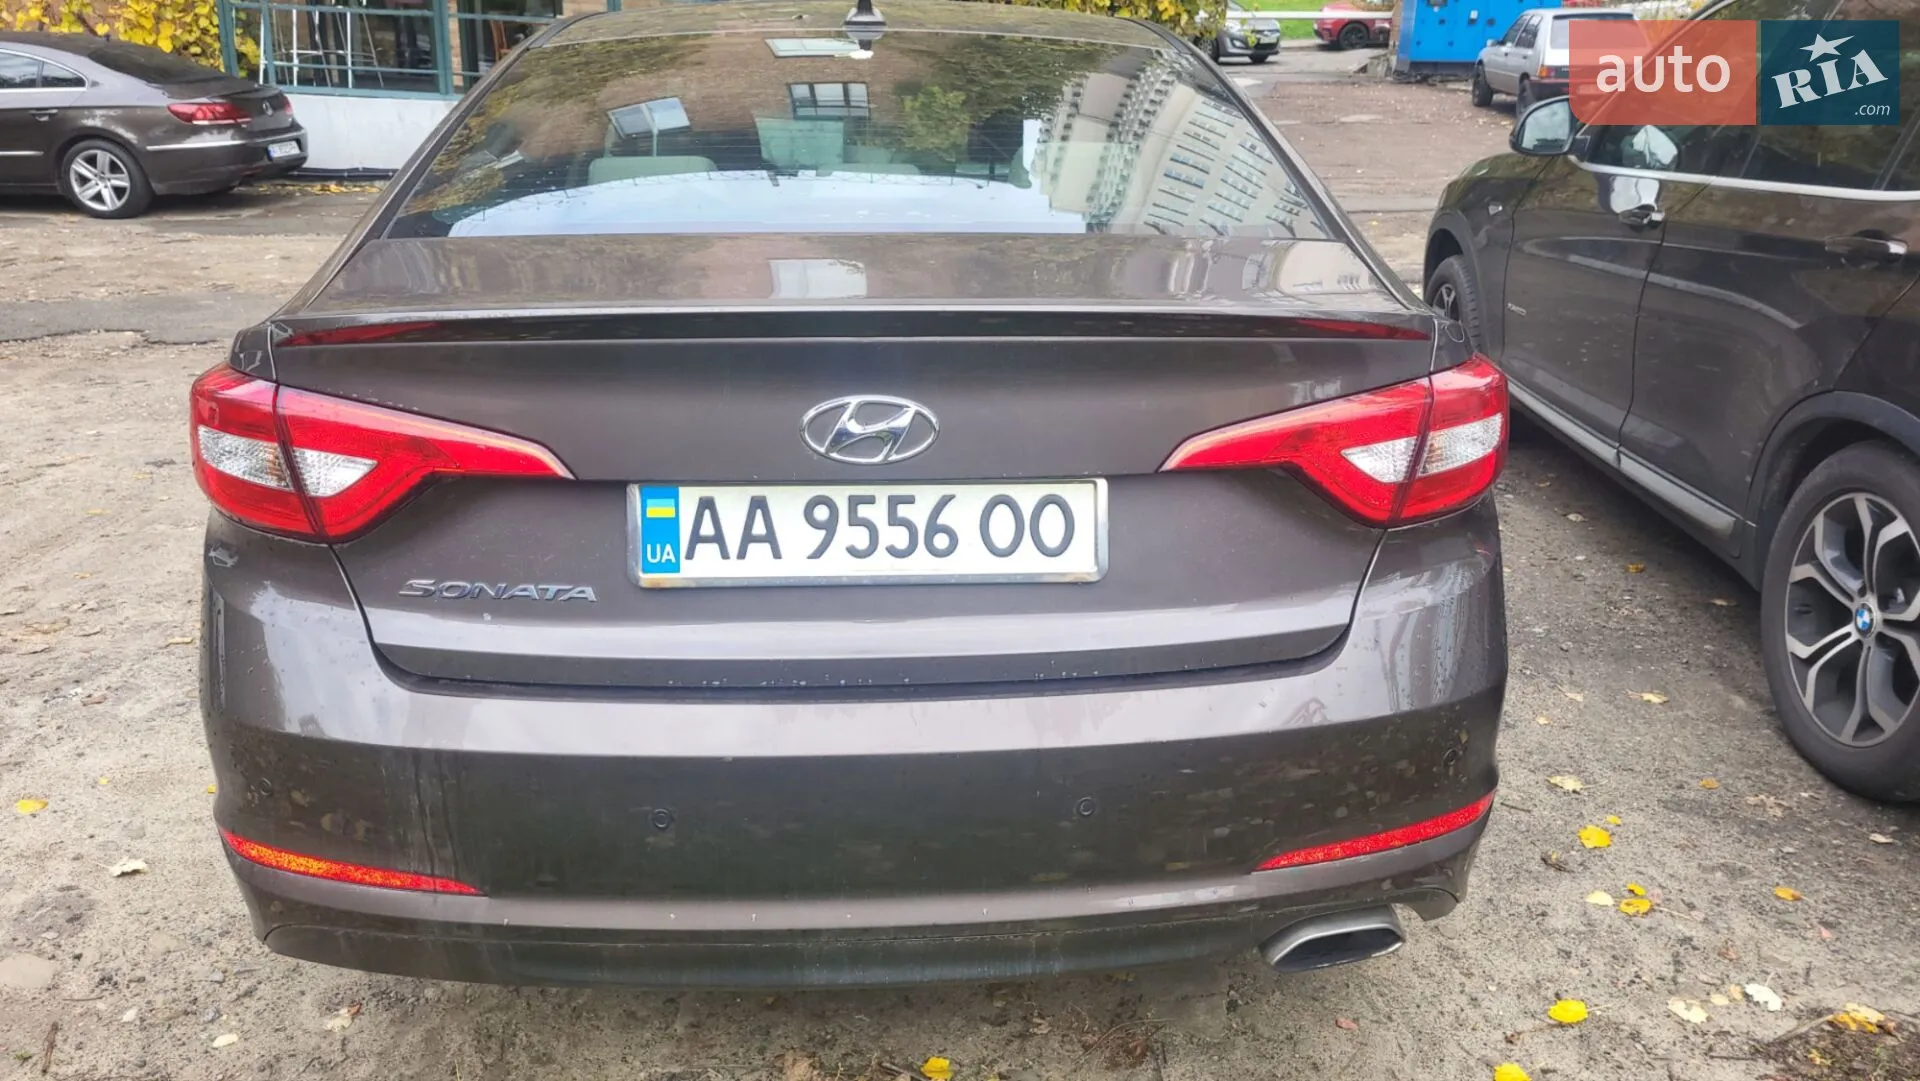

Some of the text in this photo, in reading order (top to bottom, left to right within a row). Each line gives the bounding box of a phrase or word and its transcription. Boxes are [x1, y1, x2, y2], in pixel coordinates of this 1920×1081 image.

[684, 495, 782, 560] AA
[803, 494, 959, 560] 9556
[646, 544, 676, 563] UA
[399, 579, 598, 602] SONATA
